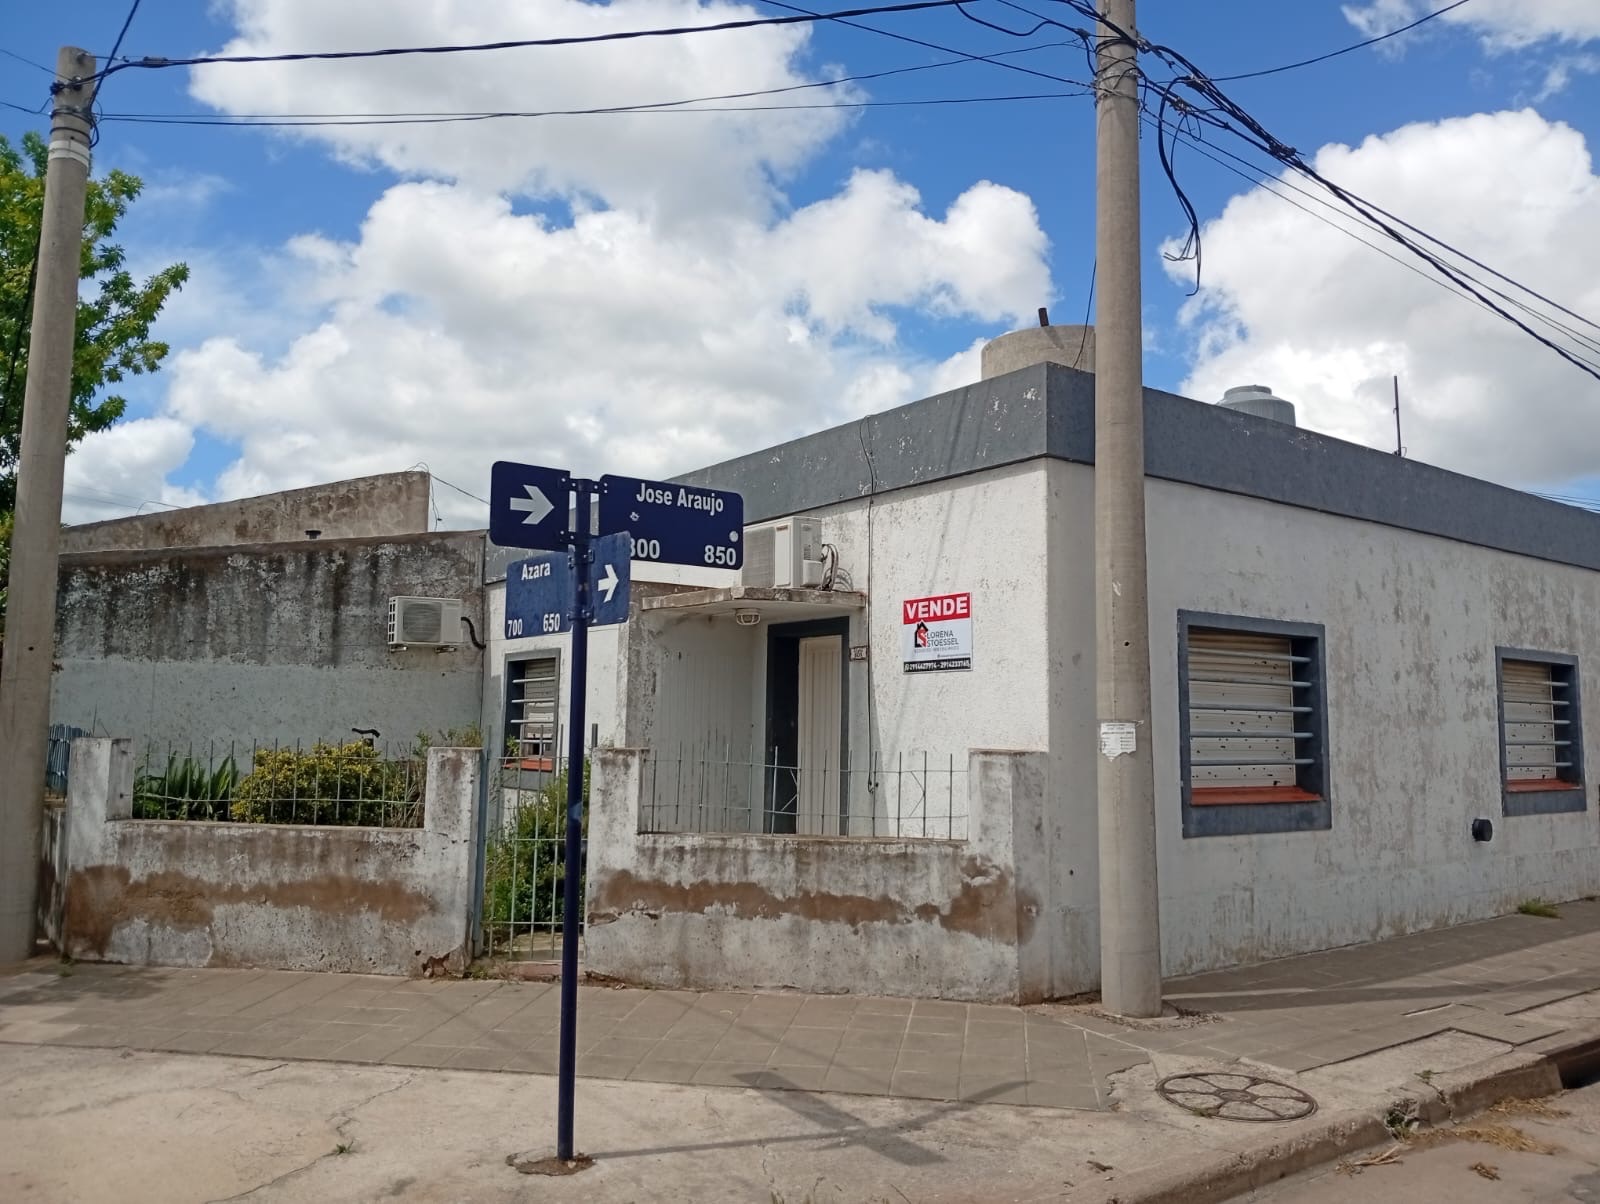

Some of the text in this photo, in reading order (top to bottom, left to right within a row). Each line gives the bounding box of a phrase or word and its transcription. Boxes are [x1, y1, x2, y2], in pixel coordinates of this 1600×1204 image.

[636, 483, 724, 516] Jose Araujo
[704, 544, 737, 566] 850
[521, 562, 551, 581] Azara
[906, 596, 968, 619] VENDE
[507, 613, 561, 637] 700 650
[926, 630, 954, 639] LORENA
[927, 638, 959, 647] STOESSEL
